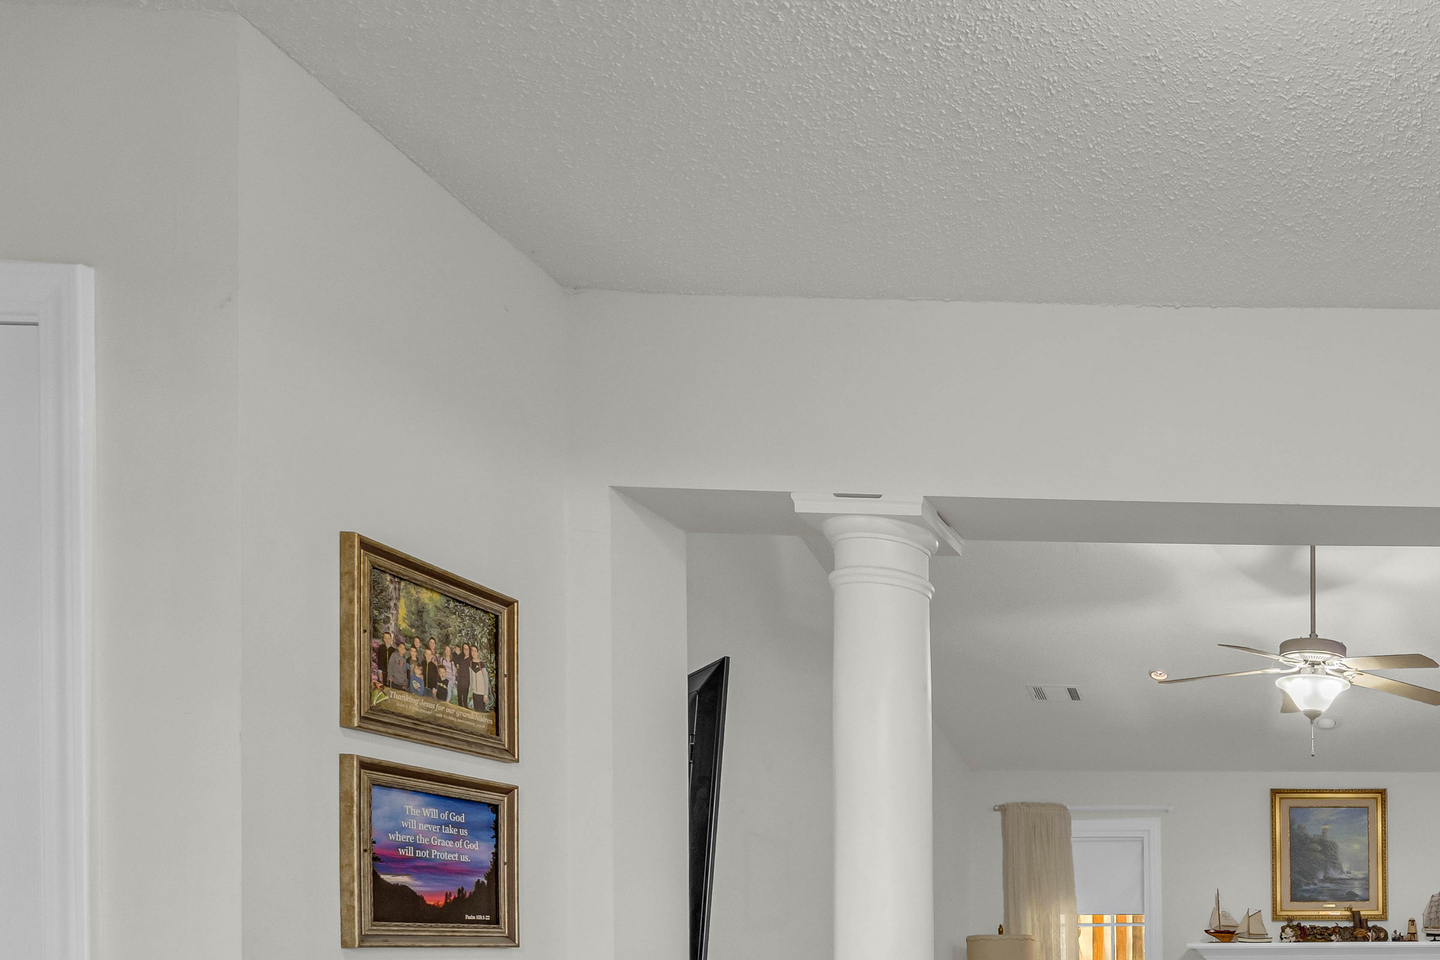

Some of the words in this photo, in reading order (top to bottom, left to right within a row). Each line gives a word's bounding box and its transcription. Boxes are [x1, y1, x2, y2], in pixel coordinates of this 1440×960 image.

[389, 690, 419, 704] Thanking
[419, 699, 435, 709] Jesus
[435, 702, 445, 711] for
[404, 805, 420, 816] The
[422, 808, 438, 819] Will
[441, 811, 450, 819] of
[450, 813, 465, 822] God
[401, 820, 416, 829] will
[419, 823, 440, 832] never
[443, 825, 458, 834] take
[388, 832, 414, 842] where
[417, 835, 430, 844] the
[431, 837, 453, 847] Grace
[455, 840, 464, 848] of
[464, 841, 479, 850] God
[398, 847, 414, 856] will
[416, 850, 429, 858] not
[432, 851, 458, 861] Protect
